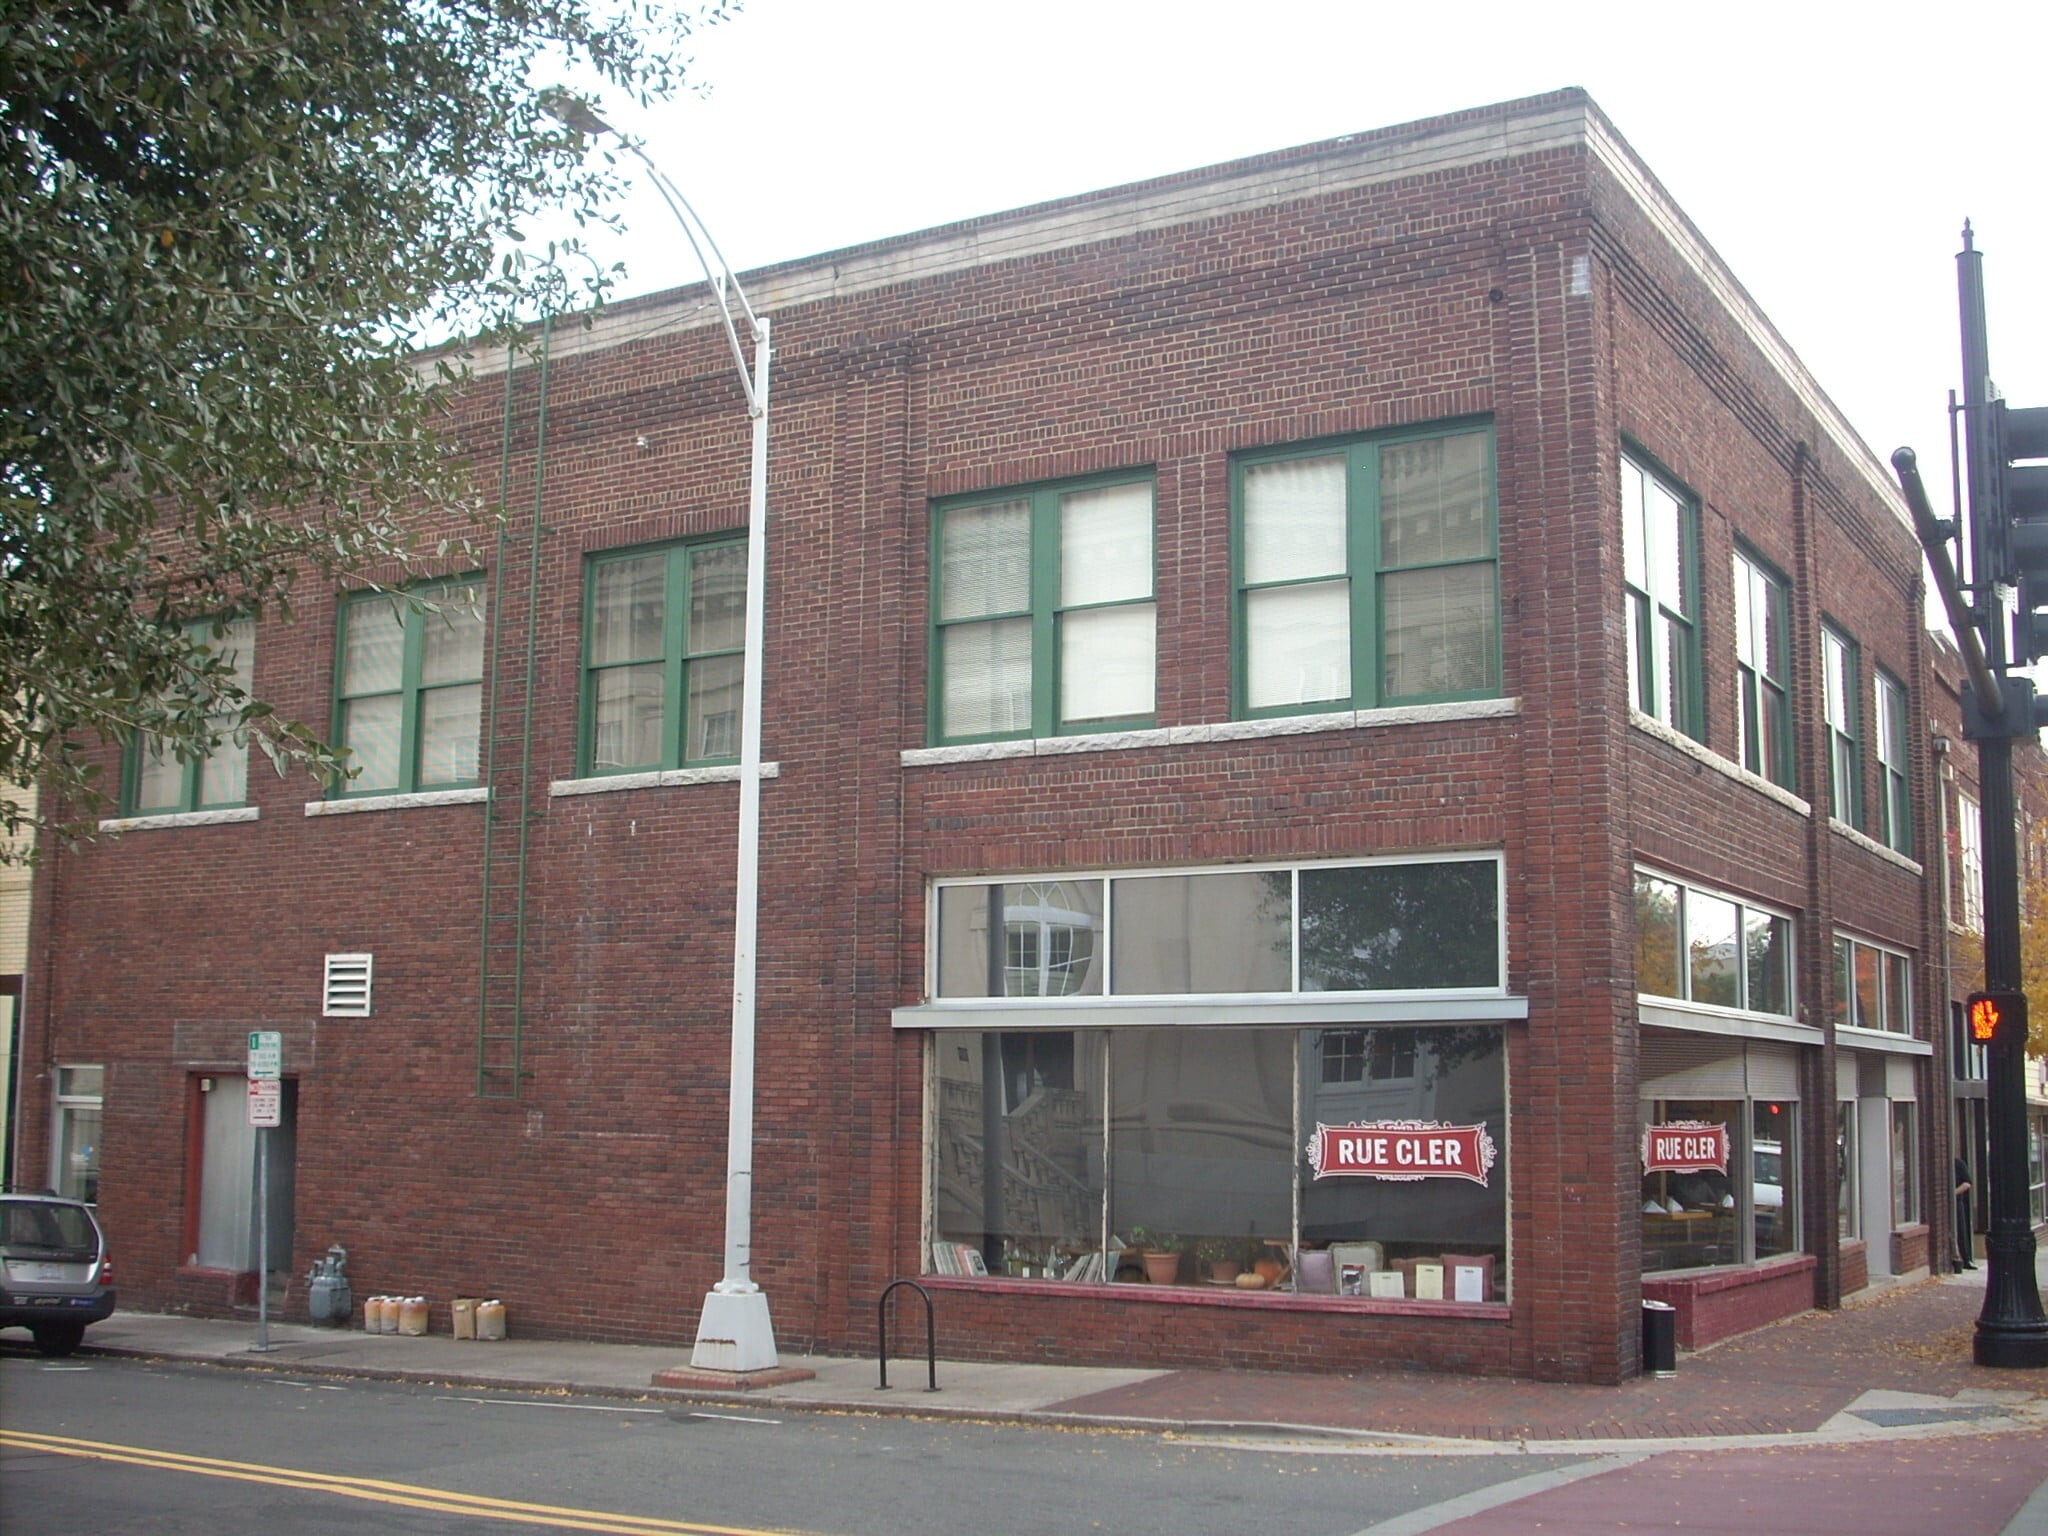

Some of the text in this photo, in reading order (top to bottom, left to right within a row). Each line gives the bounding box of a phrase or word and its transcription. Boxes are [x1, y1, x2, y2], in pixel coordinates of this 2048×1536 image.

[1338, 1138, 1462, 1166] RUE CLER
[1656, 1137, 1716, 1160] RUE CLER
